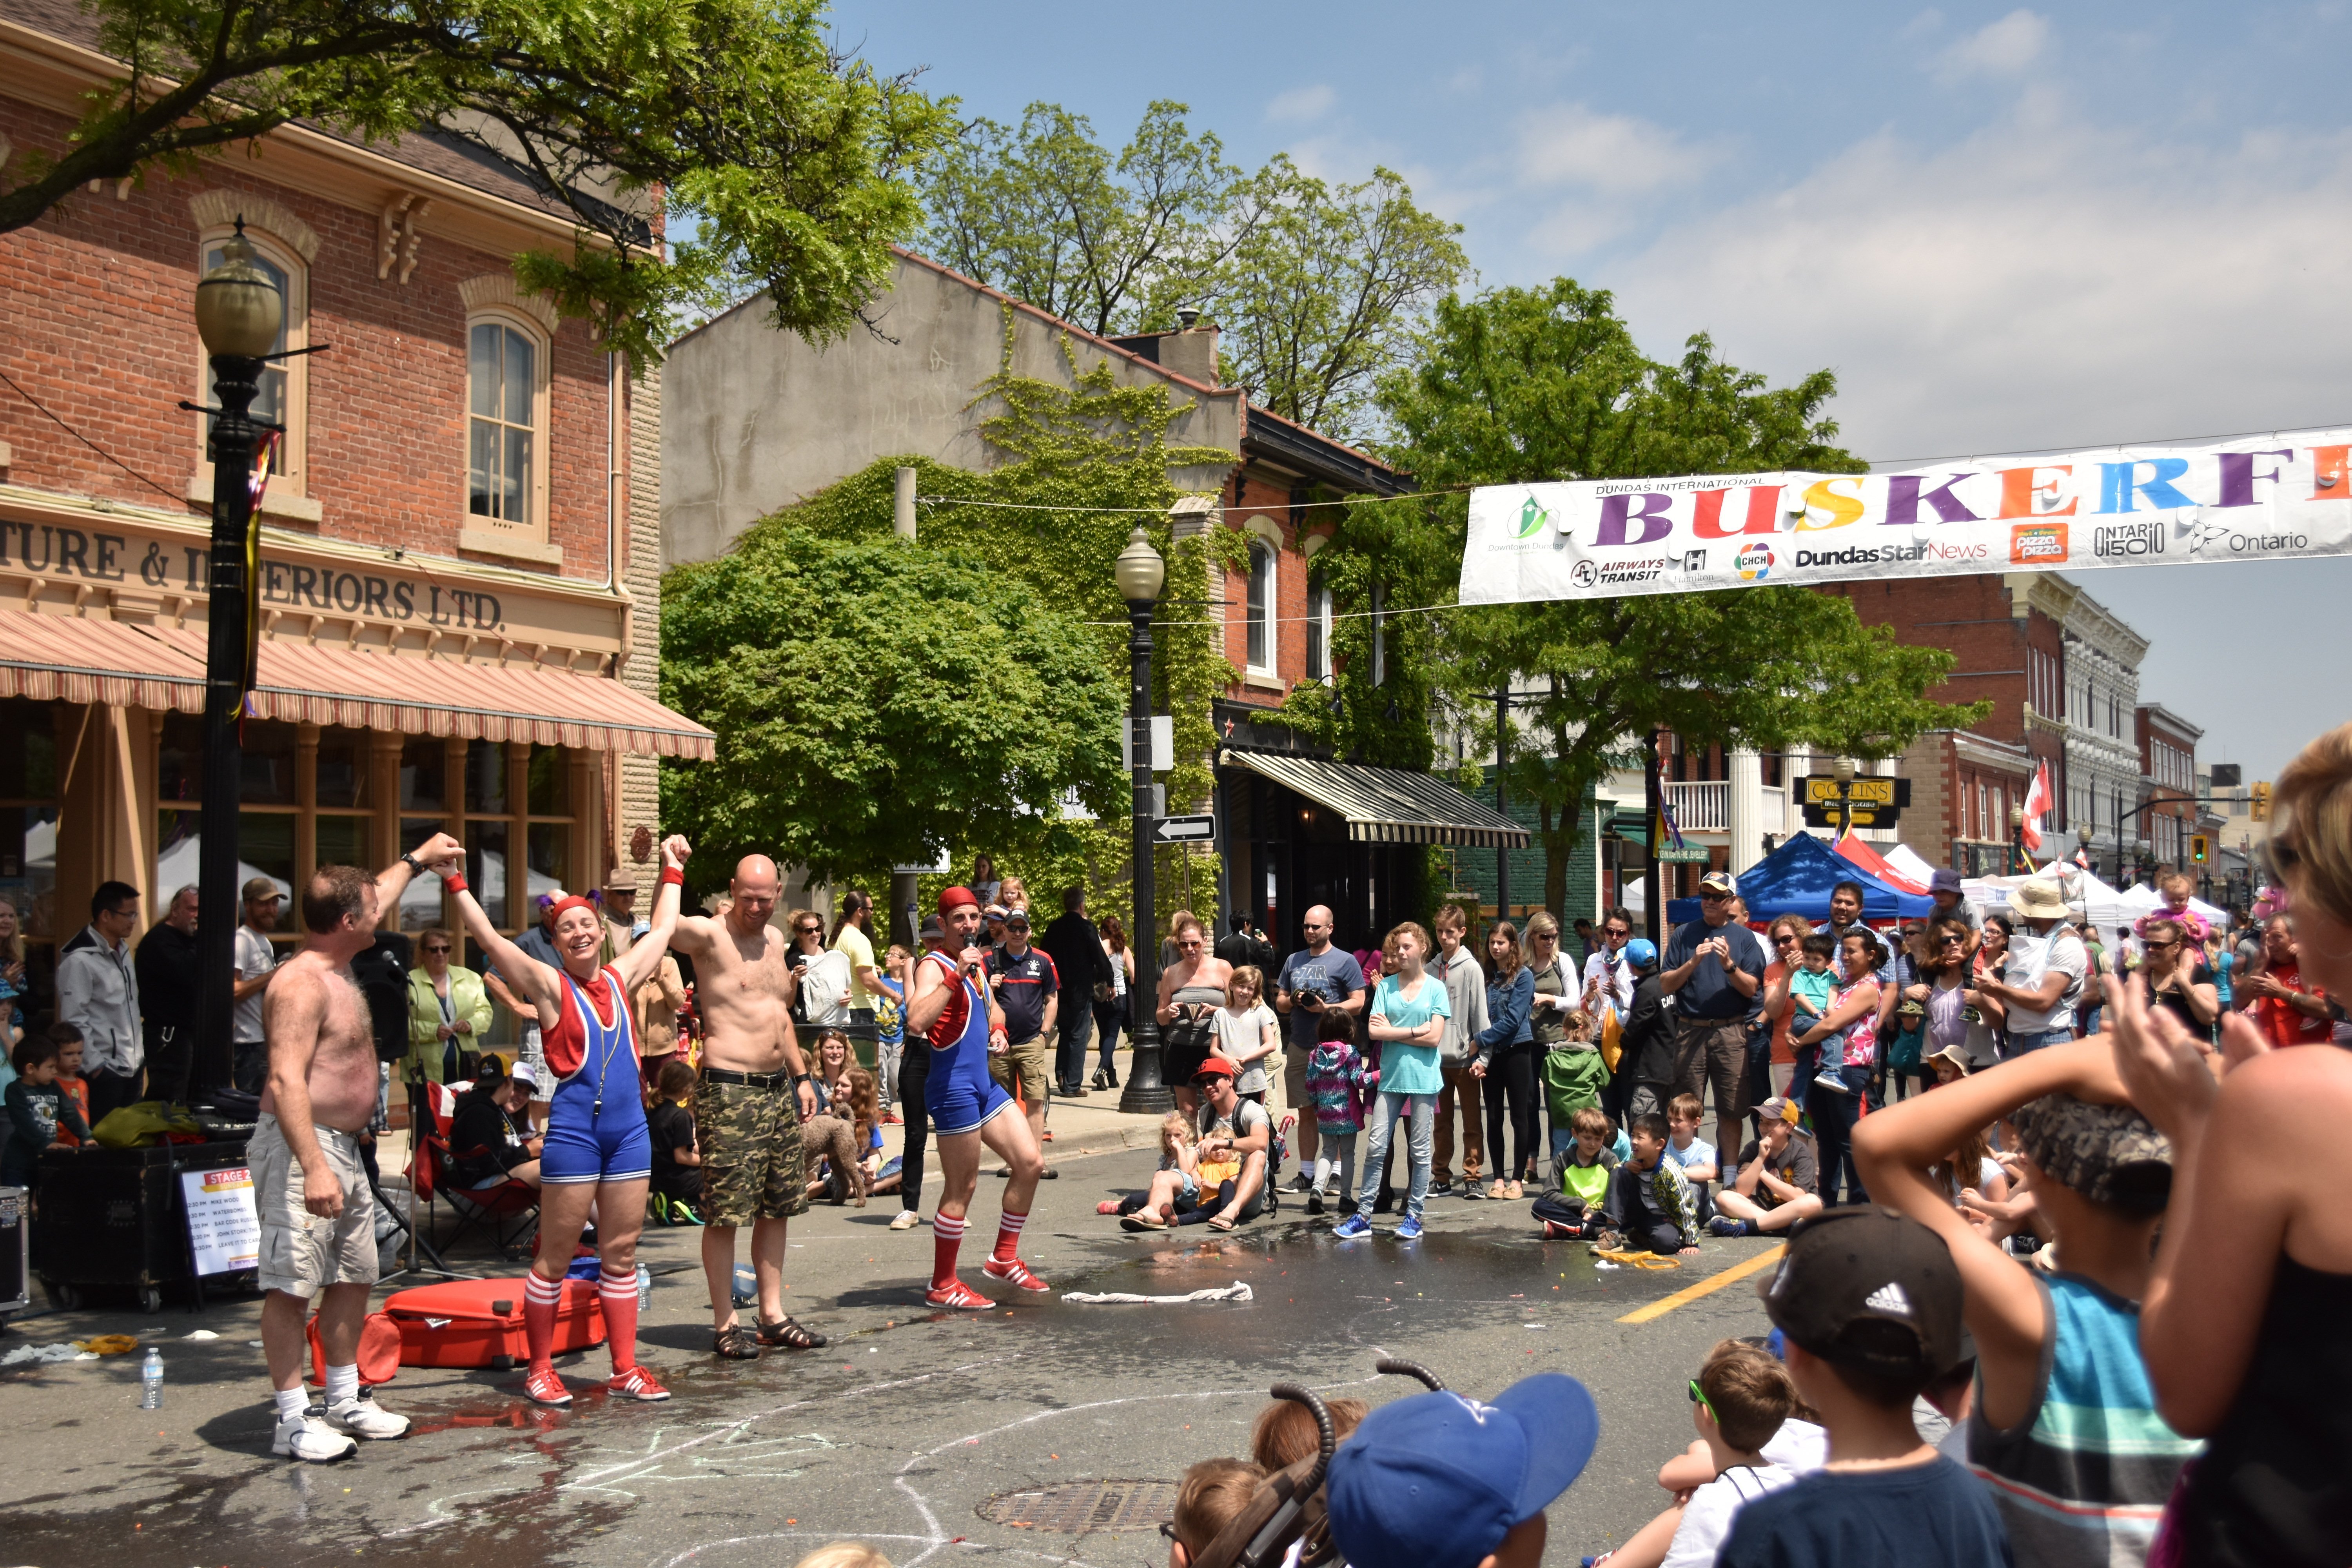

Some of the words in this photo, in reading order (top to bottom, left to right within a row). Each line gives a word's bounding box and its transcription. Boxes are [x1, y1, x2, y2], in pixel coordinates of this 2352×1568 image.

[1595, 484, 1651, 495] DUNDAS
[1656, 478, 1765, 491] INTERNATIONAL
[1488, 543, 1529, 552] Downtown
[2229, 532, 2308, 551] Ontario
[1600, 559, 1665, 572] AIRWAYS
[1742, 555, 1766, 566] CHCH
[1600, 571, 1661, 584] TRANSIT
[1674, 573, 1714, 583] Hamilton
[141, 541, 169, 587] &
[184, 546, 414, 620] IERIORS
[428, 586, 506, 632] LTD.
[1812, 782, 1888, 800] COLINS
[211, 1171, 242, 1183] STAGE
[245, 1170, 252, 1179] 2
[1866, 1297, 1908, 1313] adidas
